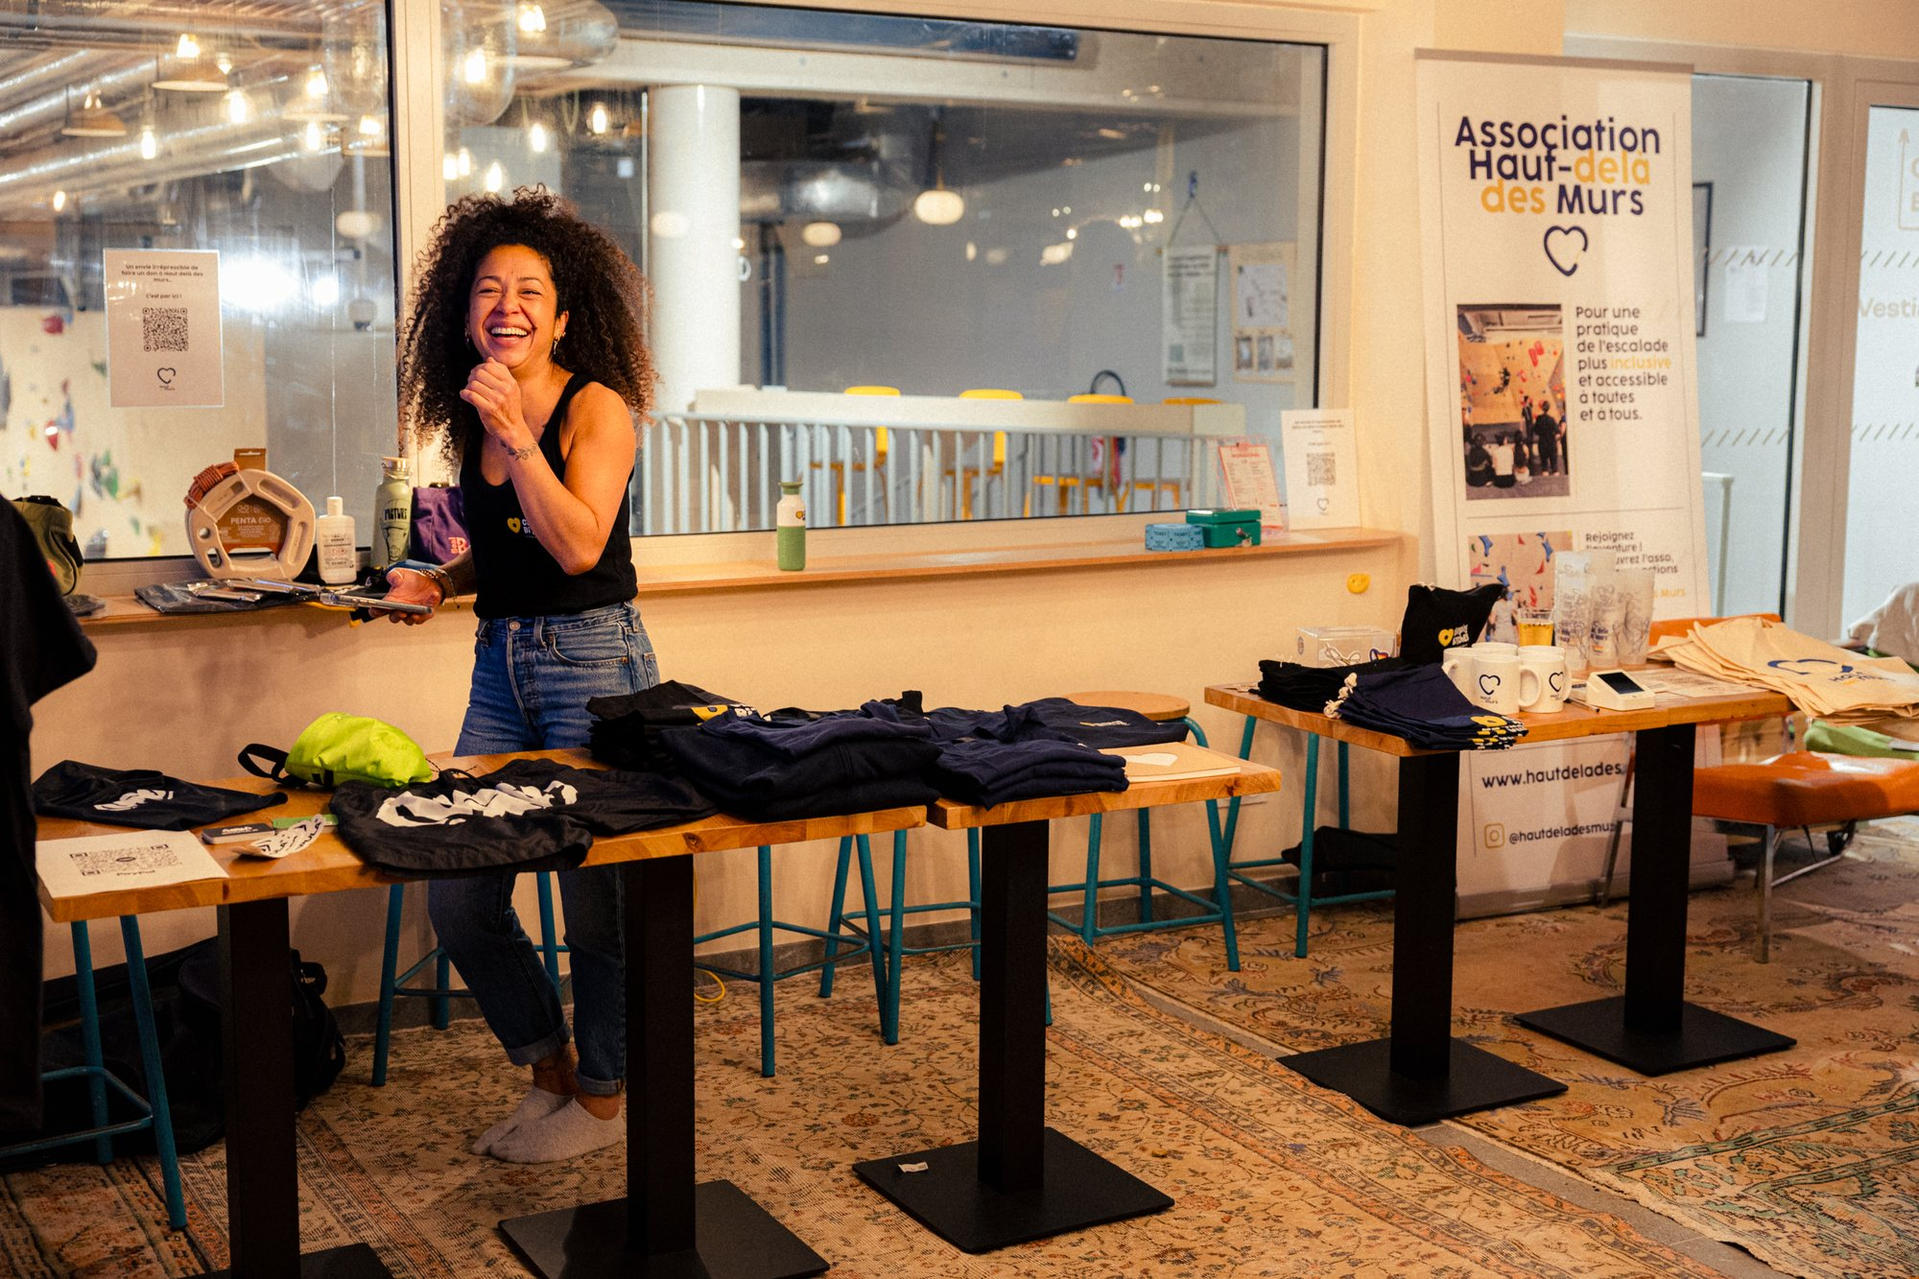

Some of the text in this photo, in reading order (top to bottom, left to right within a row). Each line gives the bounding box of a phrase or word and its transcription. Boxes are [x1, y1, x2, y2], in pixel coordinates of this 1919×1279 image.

[1455, 115, 1660, 154] Association
[1469, 148, 1650, 185] Haut-delà
[1481, 178, 1644, 215] des Murs
[1576, 306, 1640, 318] Pour une
[1859, 297, 1919, 318] Vesti
[1577, 321, 1639, 337] pratique
[1577, 339, 1668, 352] de l'escalade
[1578, 355, 1671, 371] plus inclusive
[1579, 372, 1668, 387] et accessible
[1580, 390, 1635, 404] à toutes
[1580, 407, 1642, 421] et à tous.
[230, 516, 257, 525] PENTA
[1586, 531, 1634, 543] Rejoignez
[1482, 762, 1623, 788] www.hautdelades
